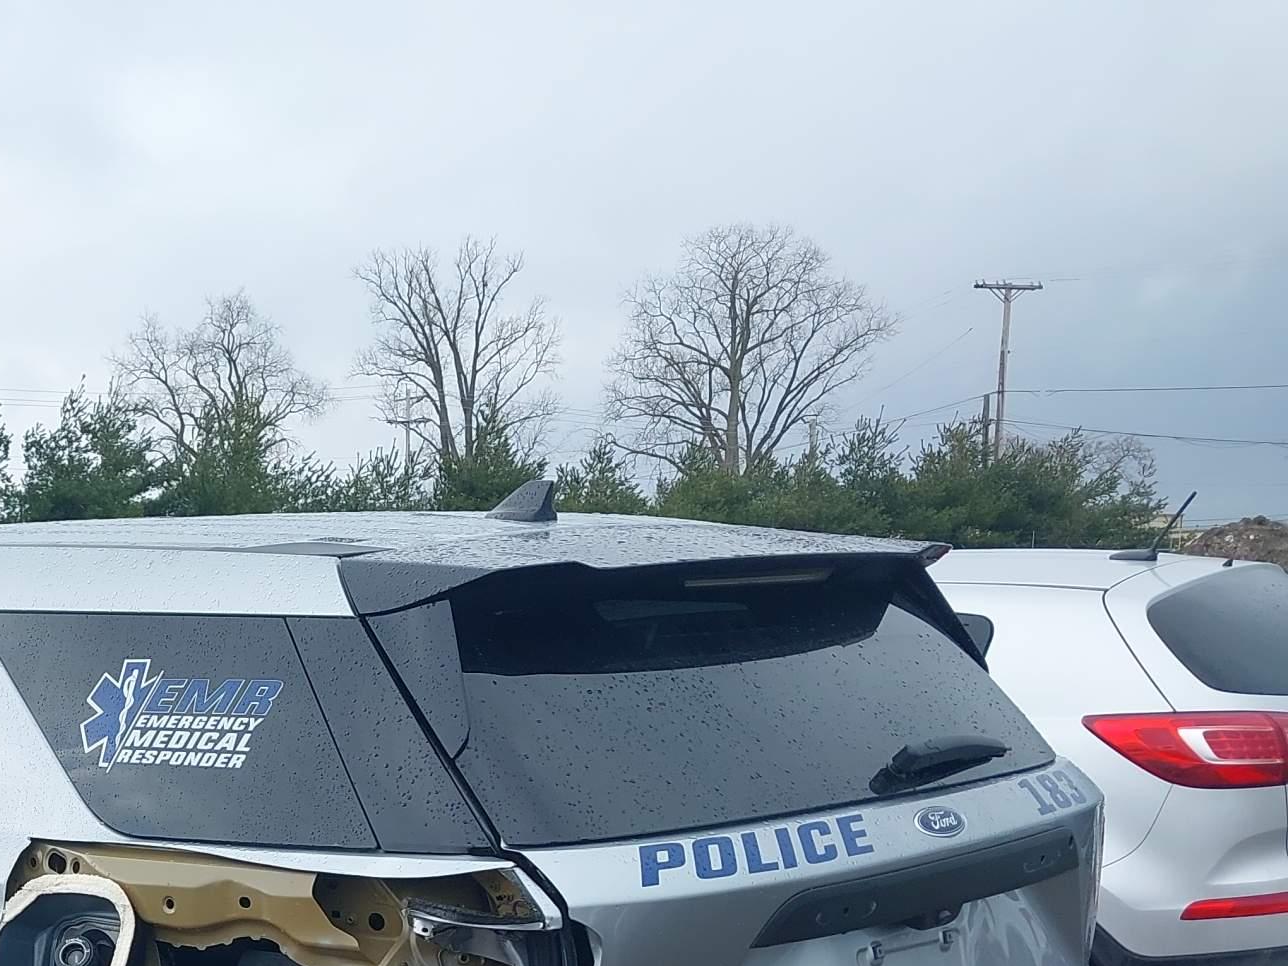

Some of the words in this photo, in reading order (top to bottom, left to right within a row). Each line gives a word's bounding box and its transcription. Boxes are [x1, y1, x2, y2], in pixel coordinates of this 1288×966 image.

[143, 679, 284, 716] EMR
[135, 715, 264, 732] EMERGENCY
[125, 729, 253, 752] MEDICAL
[116, 748, 247, 769] RESPONDER
[1017, 770, 1087, 816] 183
[928, 811, 958, 830] Ford
[637, 813, 875, 888] POLICE
